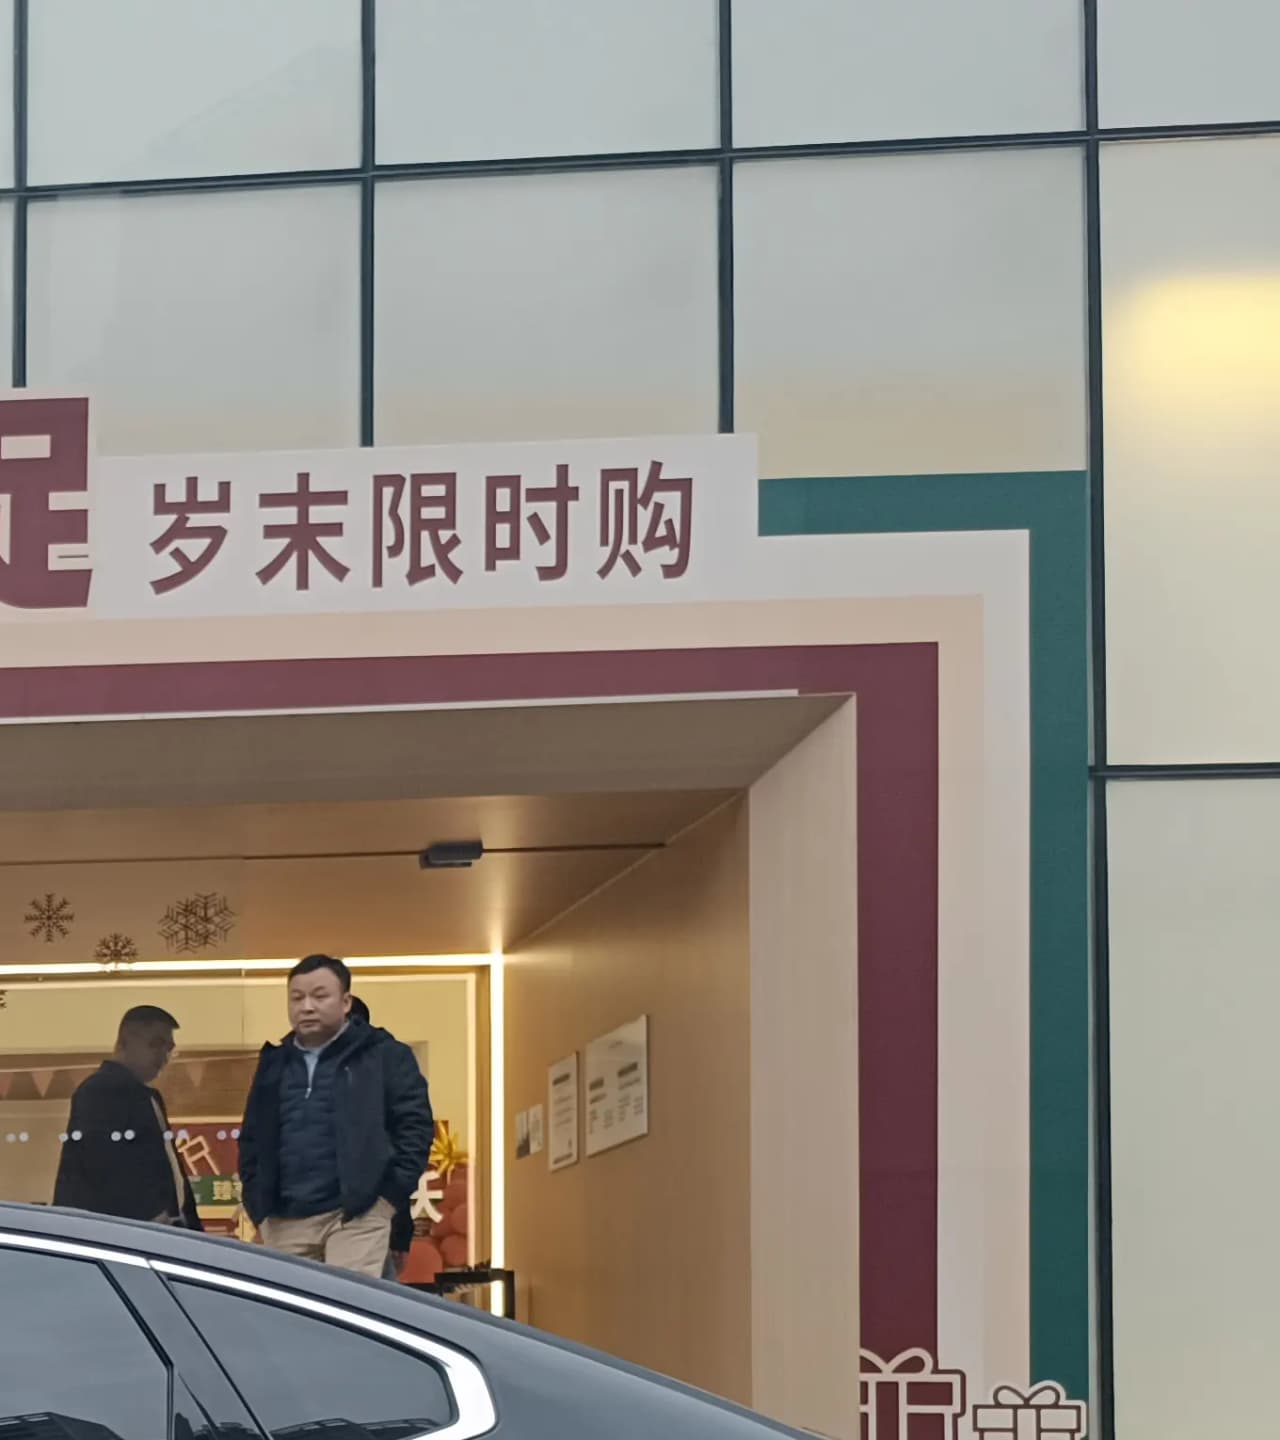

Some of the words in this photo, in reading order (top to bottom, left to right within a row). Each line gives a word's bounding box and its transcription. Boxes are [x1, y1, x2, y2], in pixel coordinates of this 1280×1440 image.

[148, 460, 696, 595] 岁末限时购
